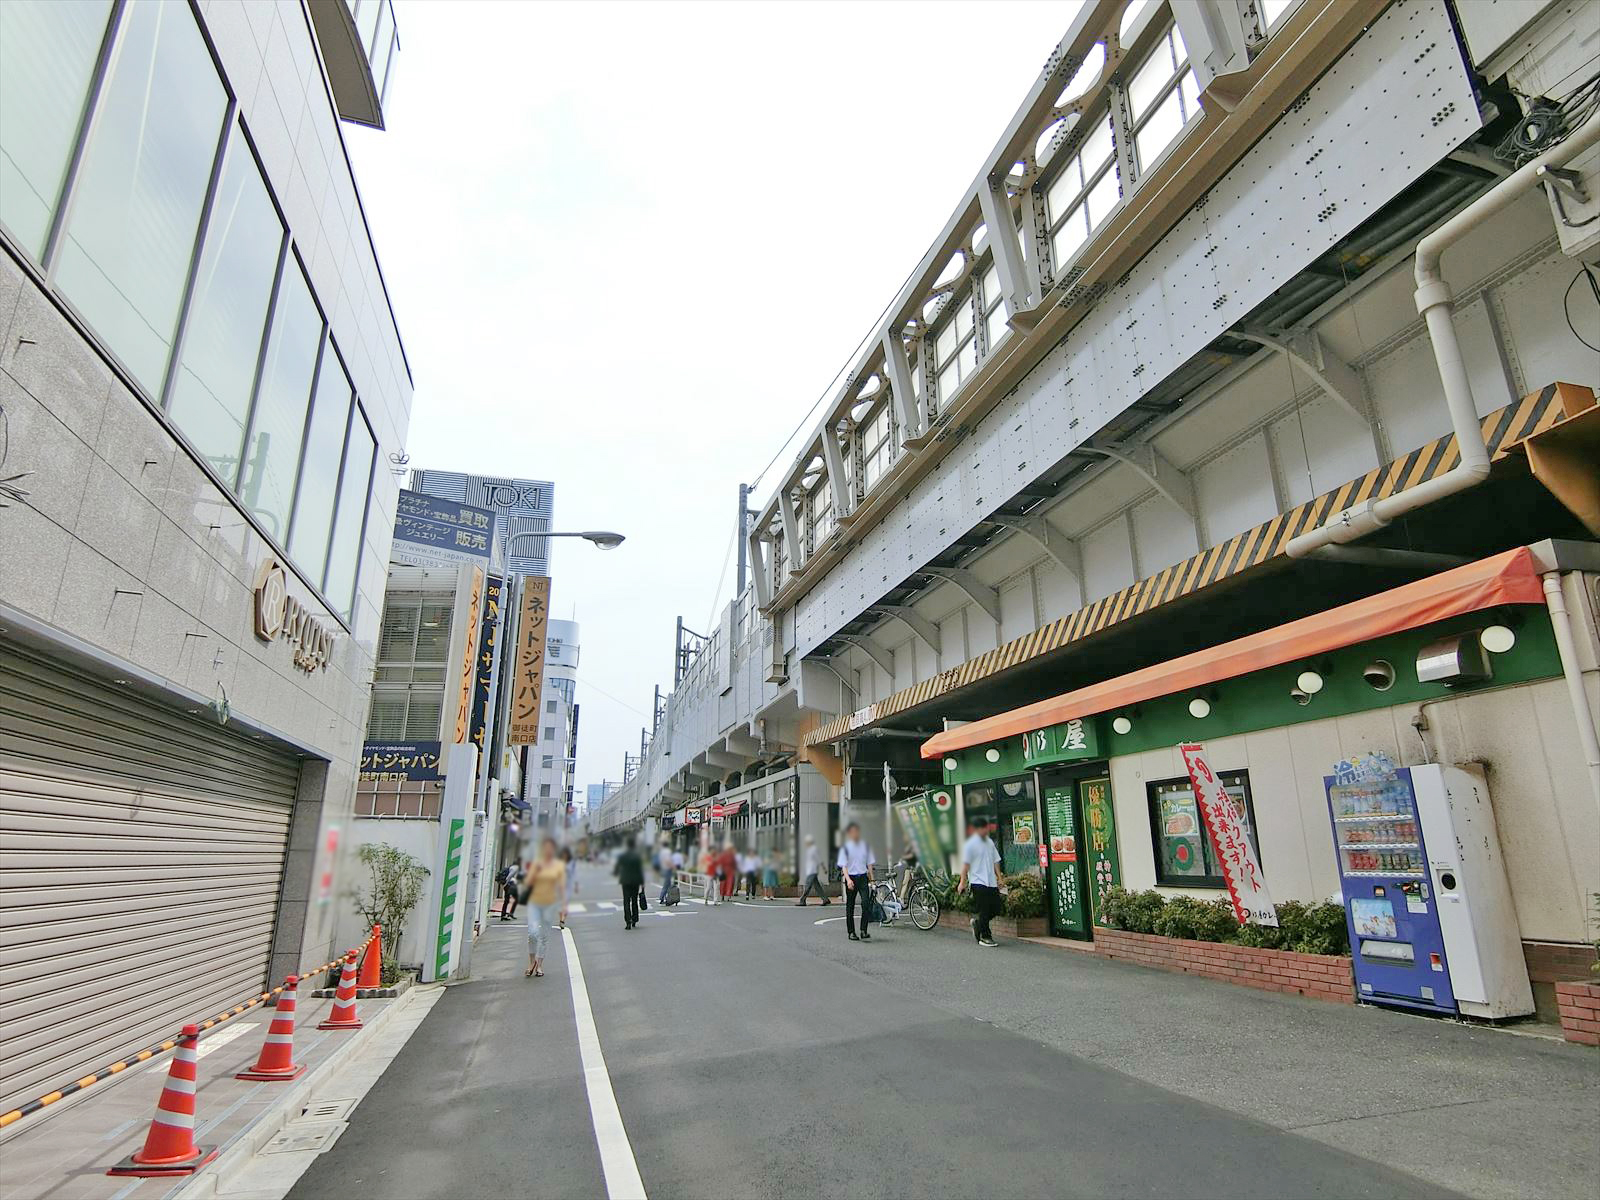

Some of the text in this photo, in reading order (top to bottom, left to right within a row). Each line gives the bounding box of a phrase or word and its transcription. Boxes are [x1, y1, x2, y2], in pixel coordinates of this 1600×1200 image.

[483, 483, 540, 510] TOKI
[459, 509, 489, 530] 買取
[455, 529, 487, 550] 販売
[518, 597, 545, 719] ネットジャパン
[360, 752, 440, 769] ットジャパン
